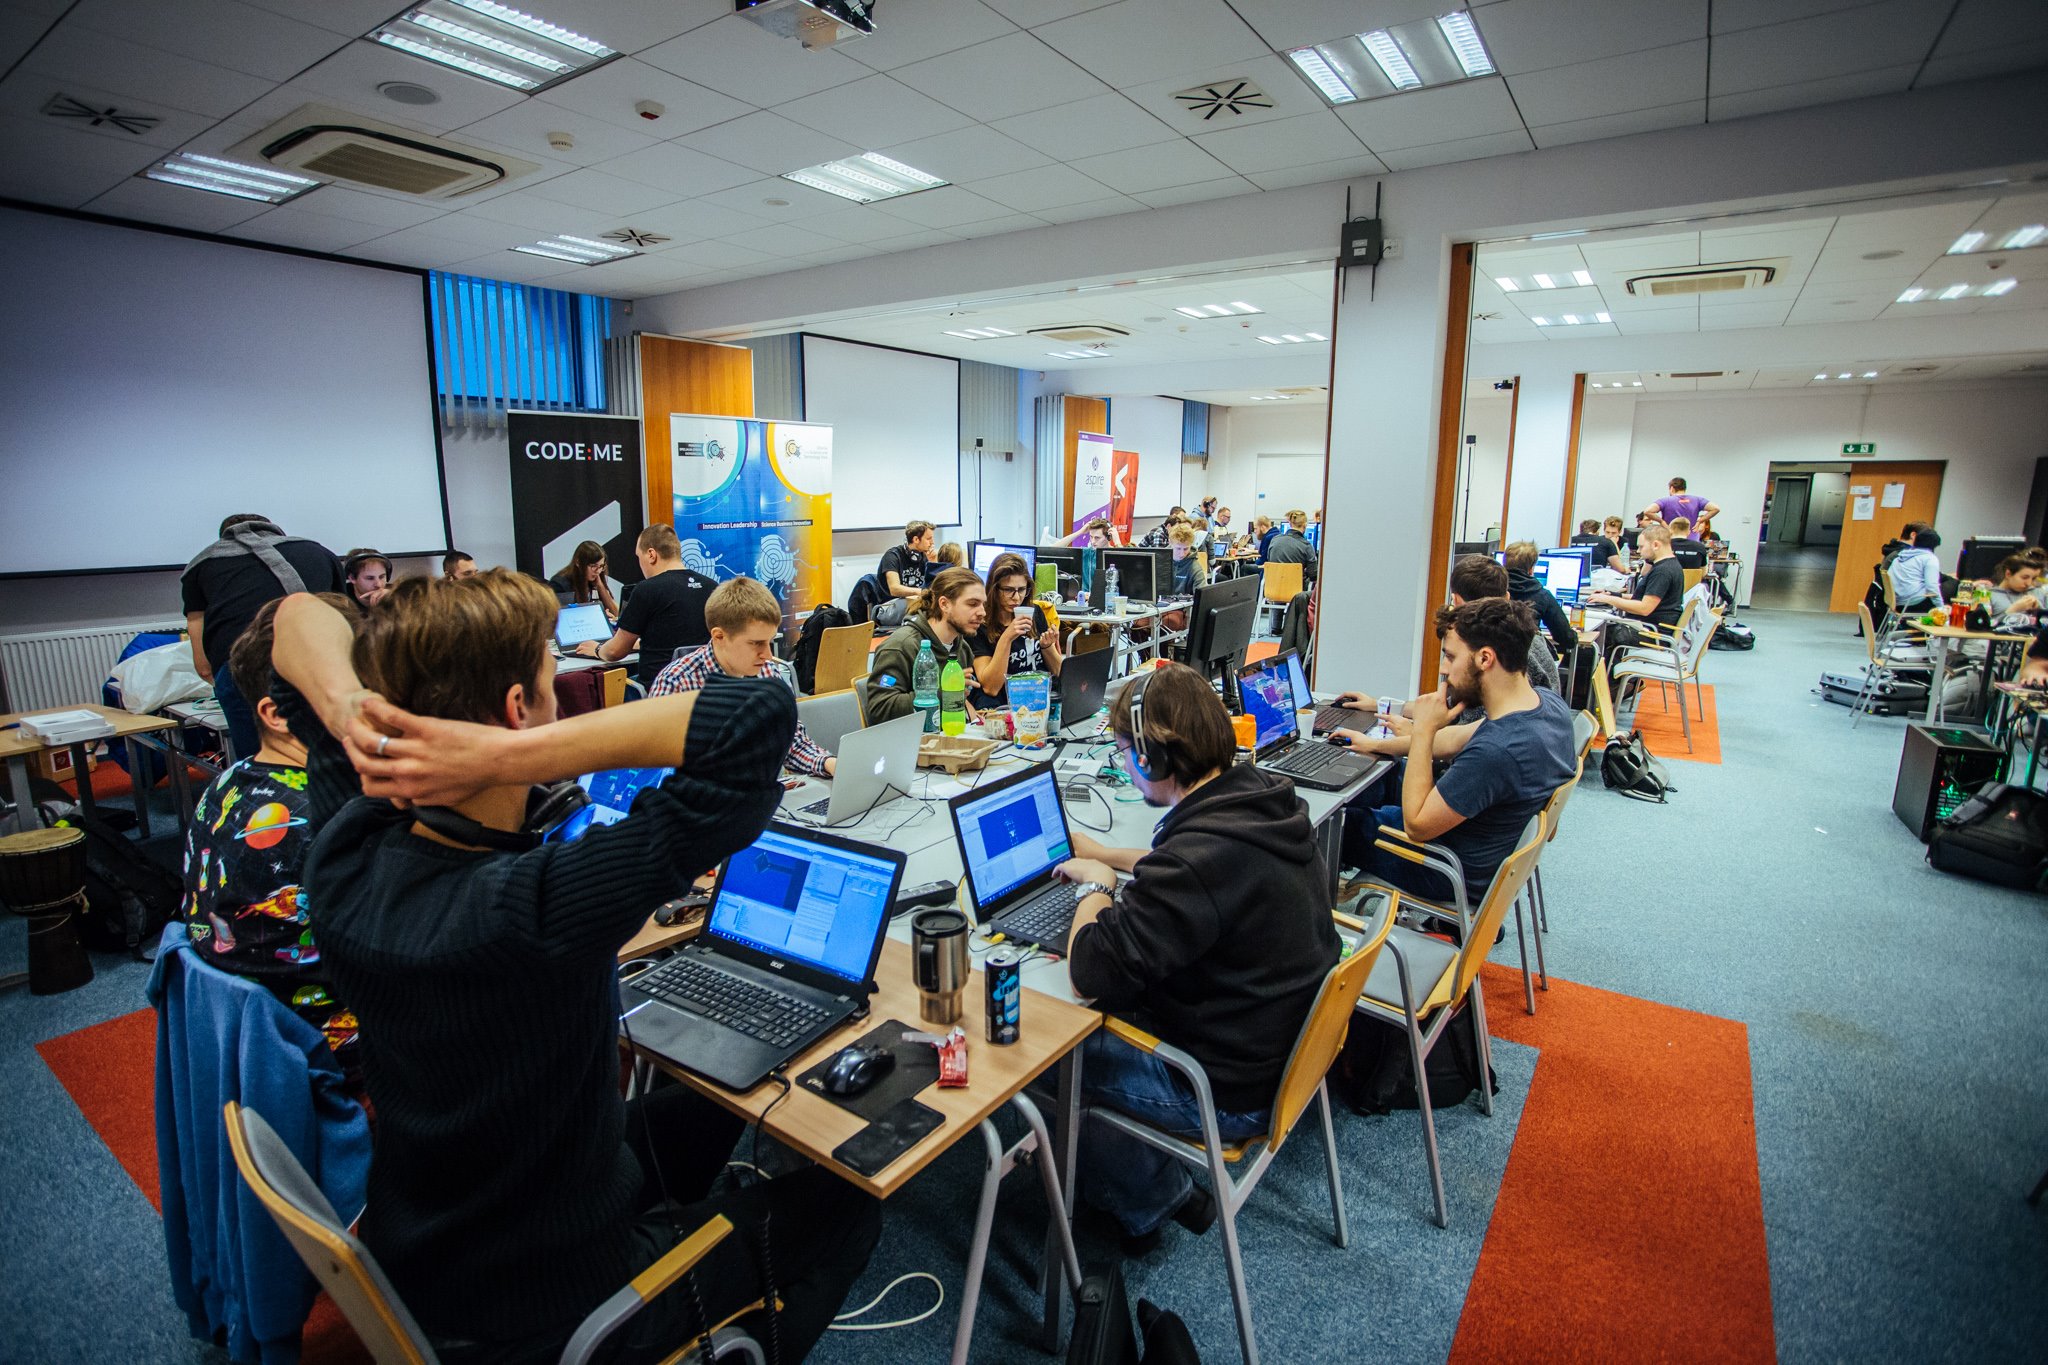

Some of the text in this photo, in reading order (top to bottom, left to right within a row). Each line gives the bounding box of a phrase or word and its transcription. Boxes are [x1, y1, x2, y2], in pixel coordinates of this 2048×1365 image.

[525, 441, 623, 461] CODE:ME
[730, 521, 758, 529] Leadership
[769, 960, 785, 970] acer
